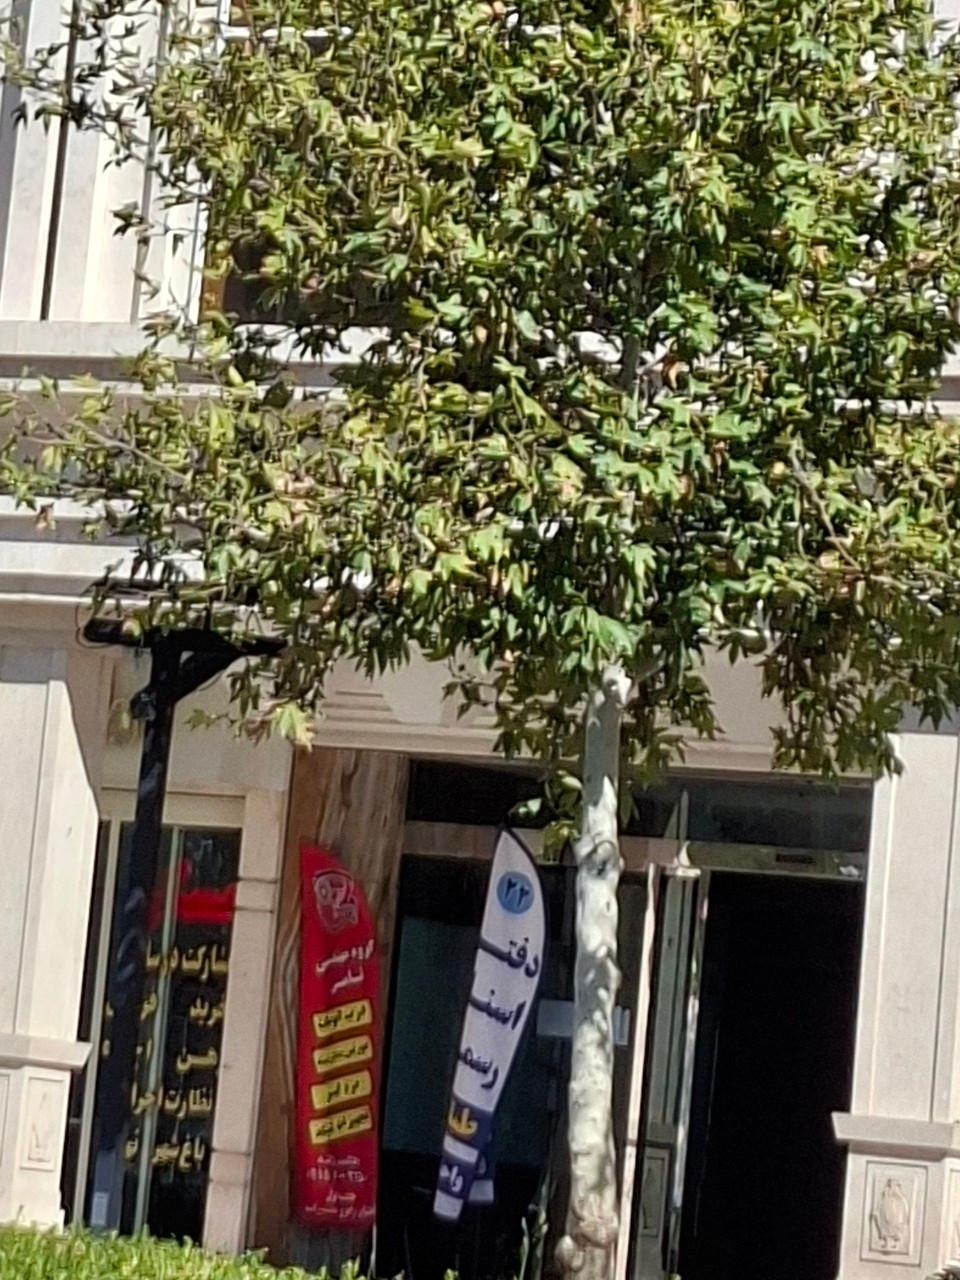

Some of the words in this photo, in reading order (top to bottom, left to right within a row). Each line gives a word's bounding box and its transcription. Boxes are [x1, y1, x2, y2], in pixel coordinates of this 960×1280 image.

[504, 876, 531, 907] ۲۲
[478, 935, 540, 979] دفت
[471, 988, 527, 1032] اسن
[460, 1046, 499, 1090] رسم
[448, 1099, 478, 1136] طلا
